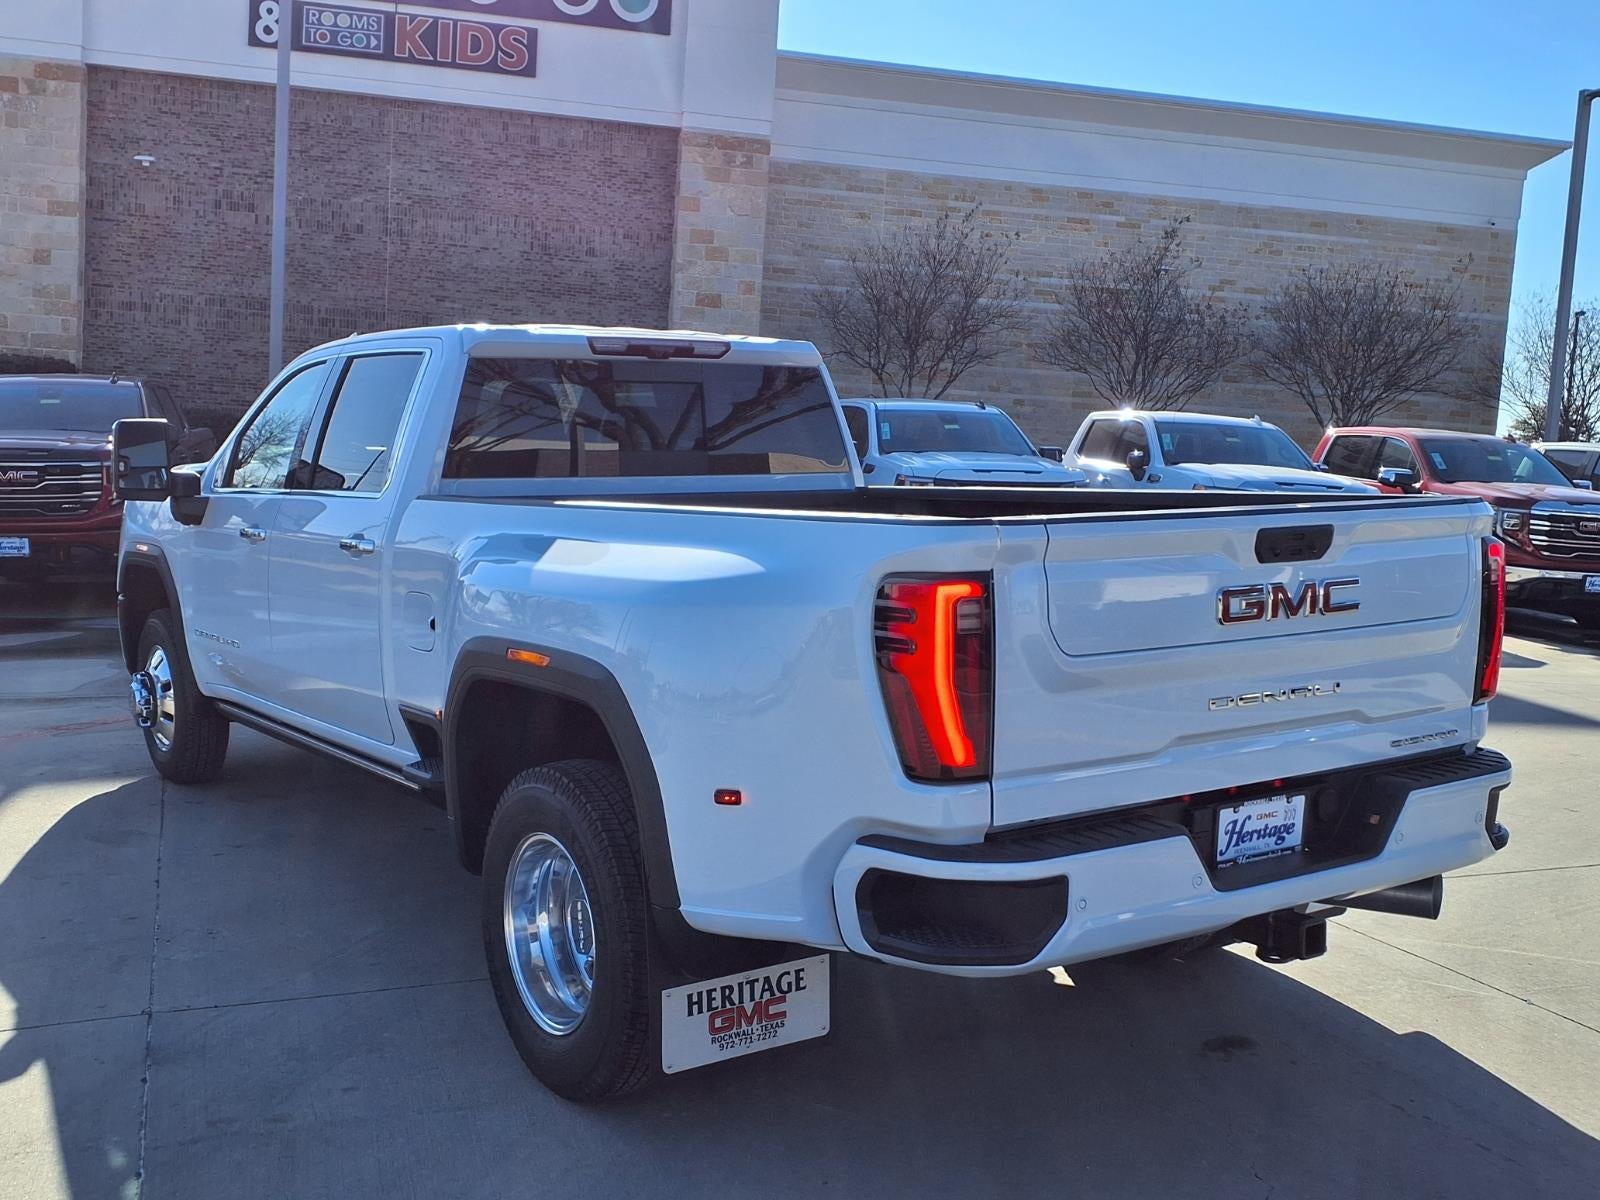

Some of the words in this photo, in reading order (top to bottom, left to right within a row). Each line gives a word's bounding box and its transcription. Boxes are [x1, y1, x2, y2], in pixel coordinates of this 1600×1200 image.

[308, 10, 378, 31] ROOMS
[308, 28, 331, 44] TO
[337, 31, 367, 48] GO
[394, 14, 529, 71] KIDS
[0, 470, 38, 481] MC
[1217, 575, 1361, 625] GMC
[1208, 681, 1341, 711] DENALI
[1391, 729, 1459, 748] SIERRA
[1256, 811, 1279, 821] GMC
[1219, 814, 1296, 857] Heritage
[686, 968, 807, 1017] HERITAGE
[708, 994, 788, 1036] GMC
[711, 1028, 756, 1046] ROCKWALL
[758, 1020, 785, 1034] TEXAS
[718, 1030, 779, 1052] 972-771-7272
